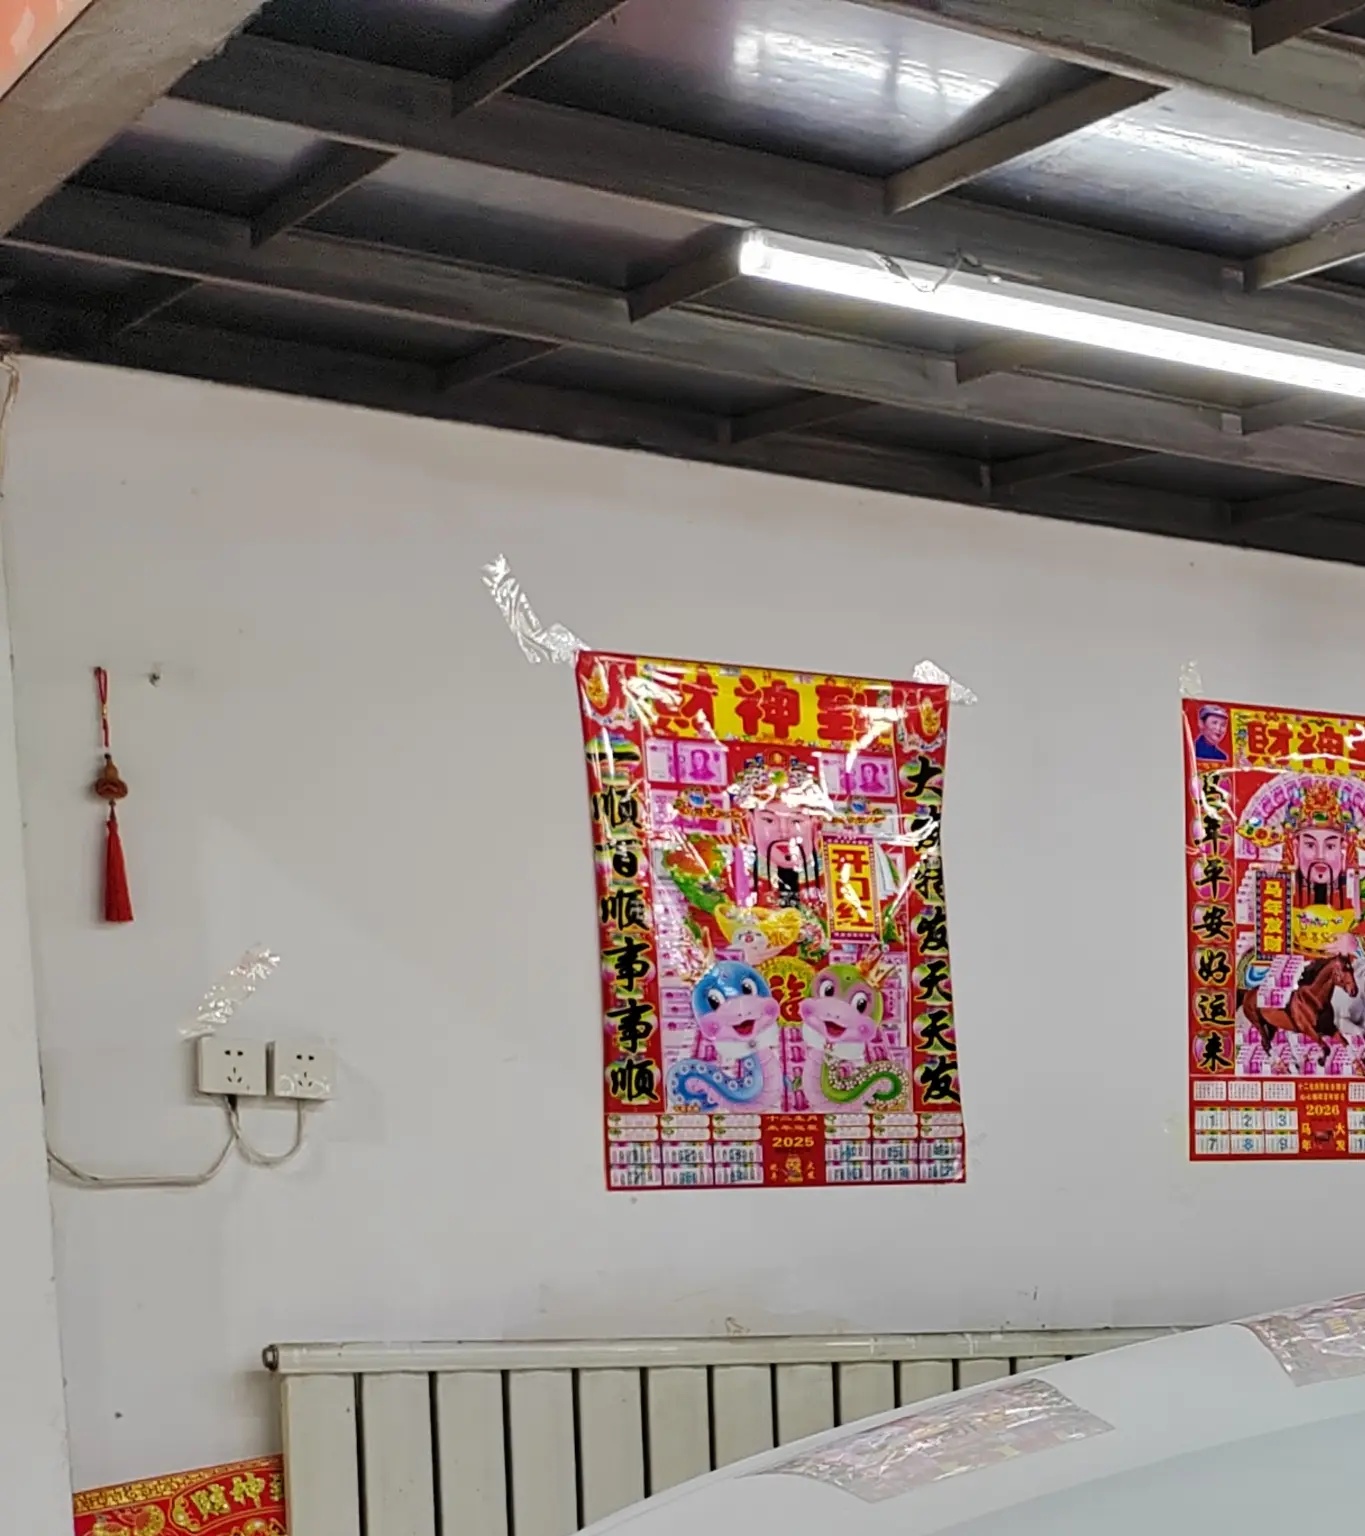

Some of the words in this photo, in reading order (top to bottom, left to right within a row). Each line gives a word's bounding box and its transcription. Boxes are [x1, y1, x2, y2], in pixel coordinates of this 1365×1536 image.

[832, 849, 874, 928] 开门红
[1305, 1104, 1341, 1116] 2026
[771, 1135, 815, 1148] 2025
